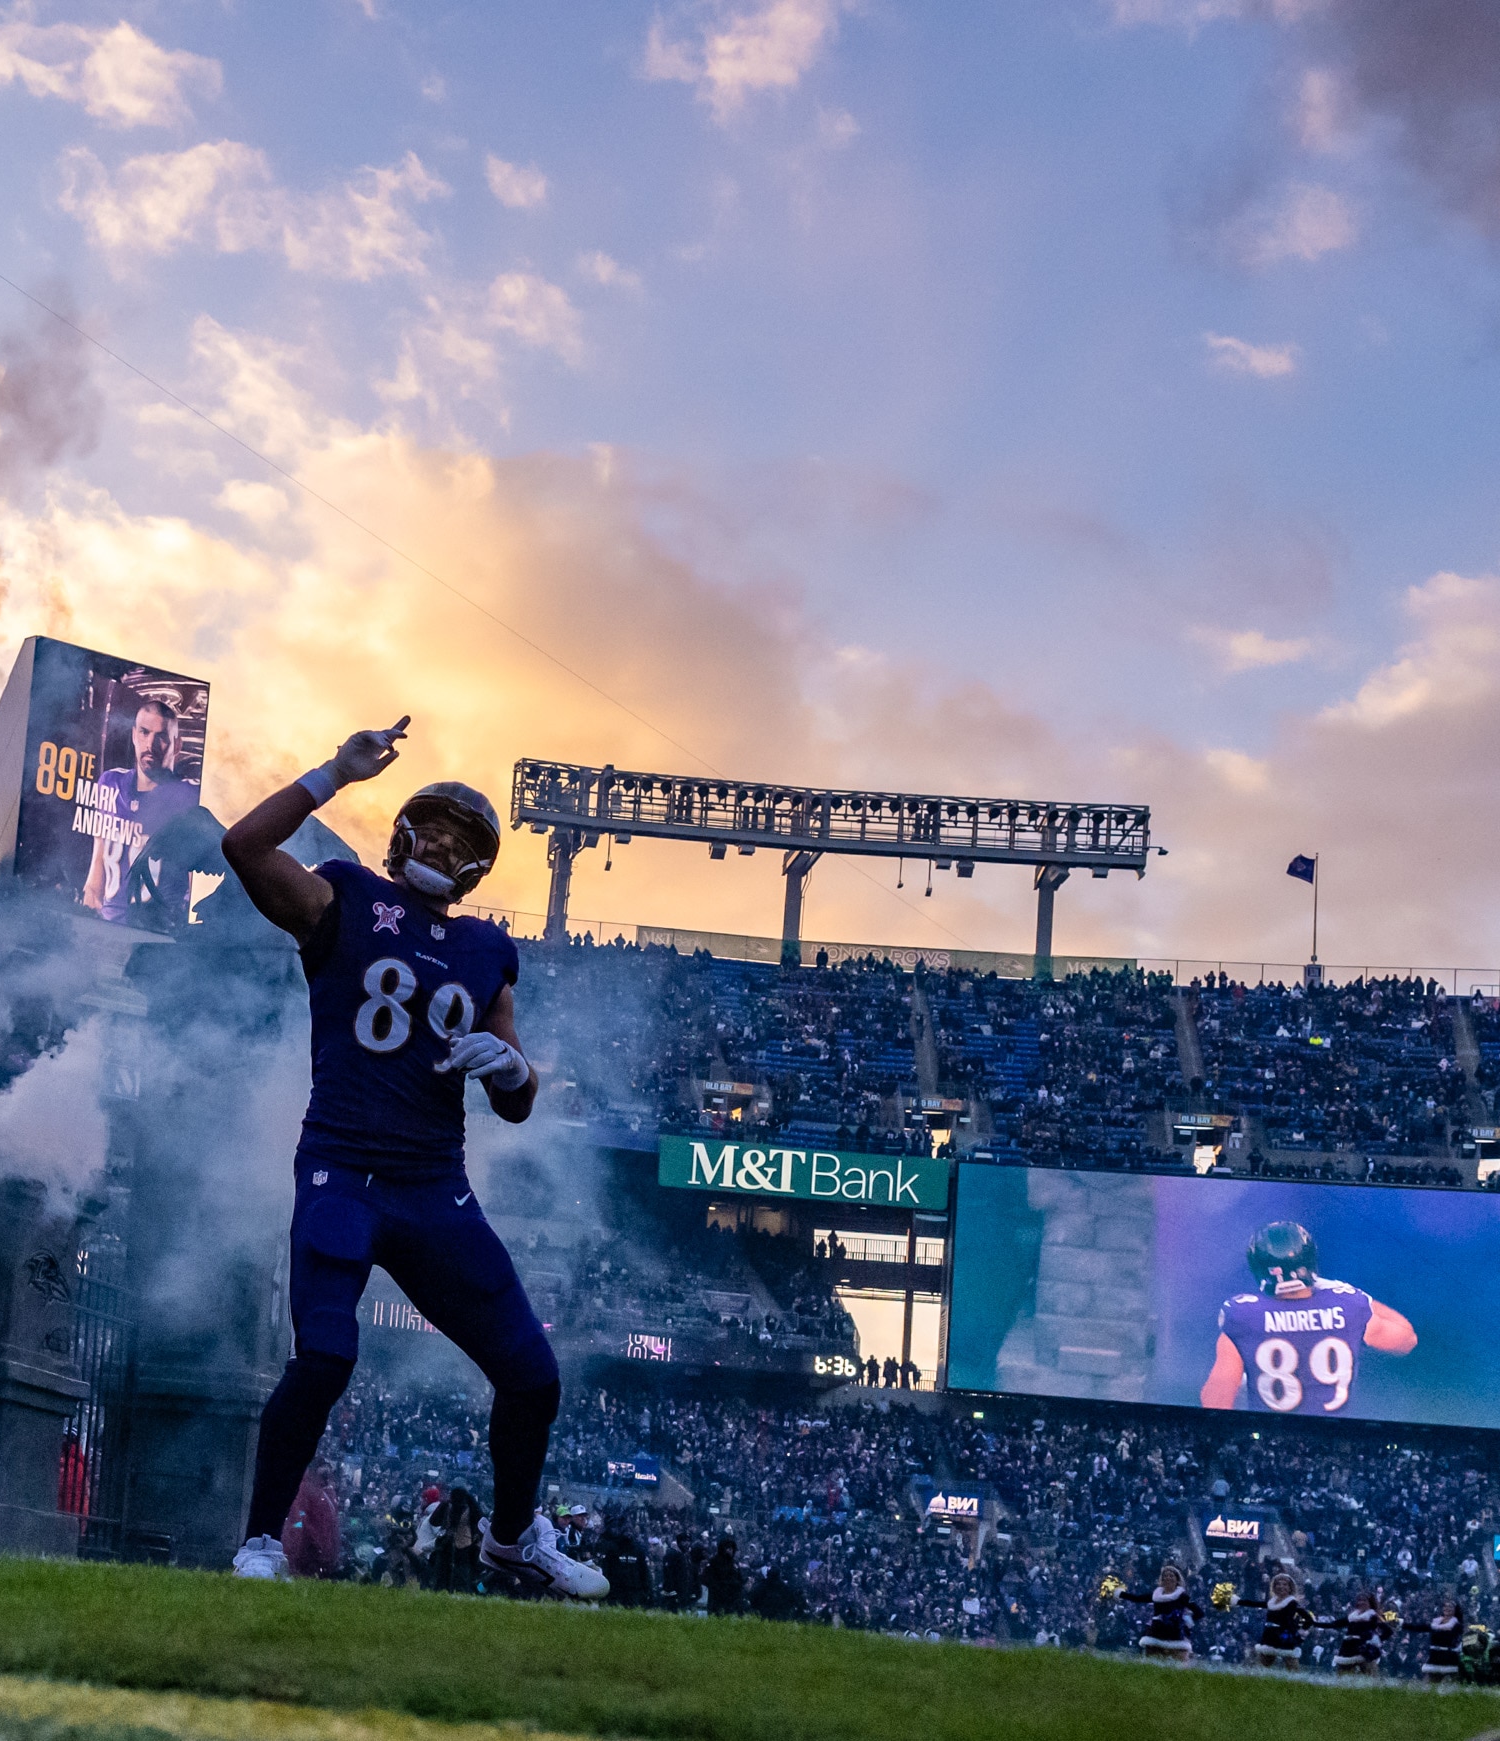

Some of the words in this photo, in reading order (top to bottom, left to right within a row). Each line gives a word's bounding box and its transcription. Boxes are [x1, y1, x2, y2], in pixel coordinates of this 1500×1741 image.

[36, 741, 78, 801] 89
[80, 751, 96, 779] TE
[76, 778, 120, 814] MARK
[72, 806, 144, 848] ANDREWS
[891, 949, 951, 967] ROWS
[688, 1142, 806, 1193] M&T
[810, 1152, 920, 1204] Bank
[1264, 1307, 1345, 1333] ANDREWS
[814, 1355, 856, 1377] 6:36
[1255, 1336, 1353, 1412] 89
[947, 1496, 979, 1511] BWI
[1227, 1519, 1260, 1535] BWI
